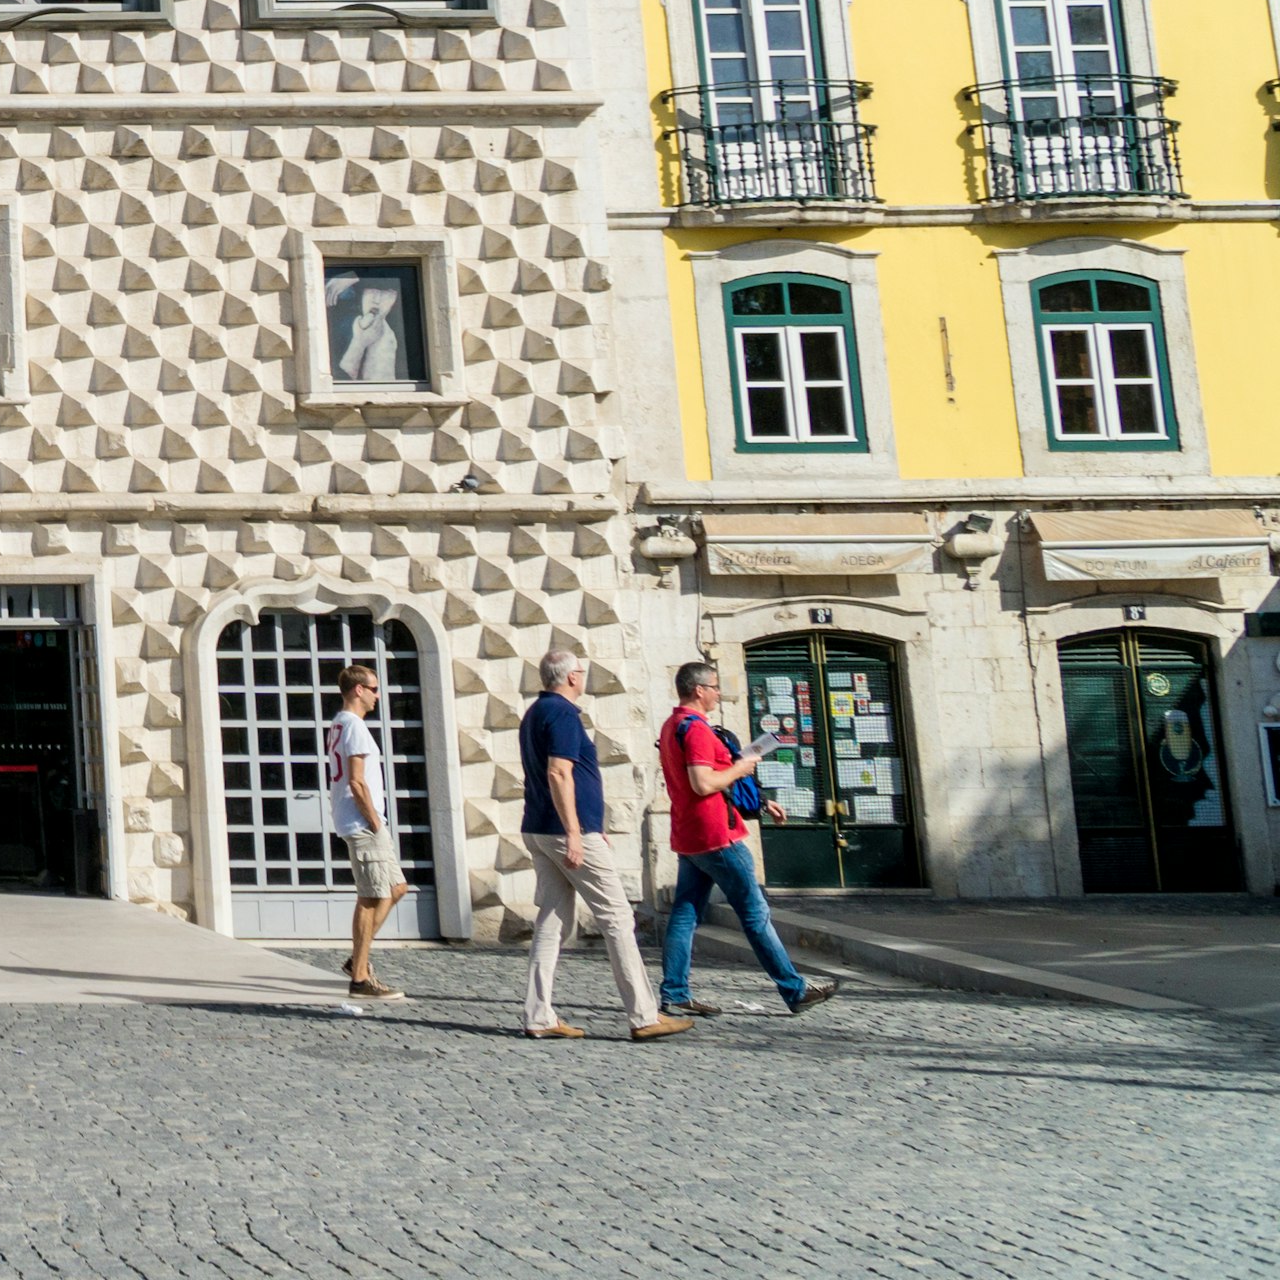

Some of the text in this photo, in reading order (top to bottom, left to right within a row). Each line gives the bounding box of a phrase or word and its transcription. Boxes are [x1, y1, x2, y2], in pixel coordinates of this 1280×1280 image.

[840, 555, 885, 566] ADEGA
[1085, 560, 1148, 571] DO ATUM
